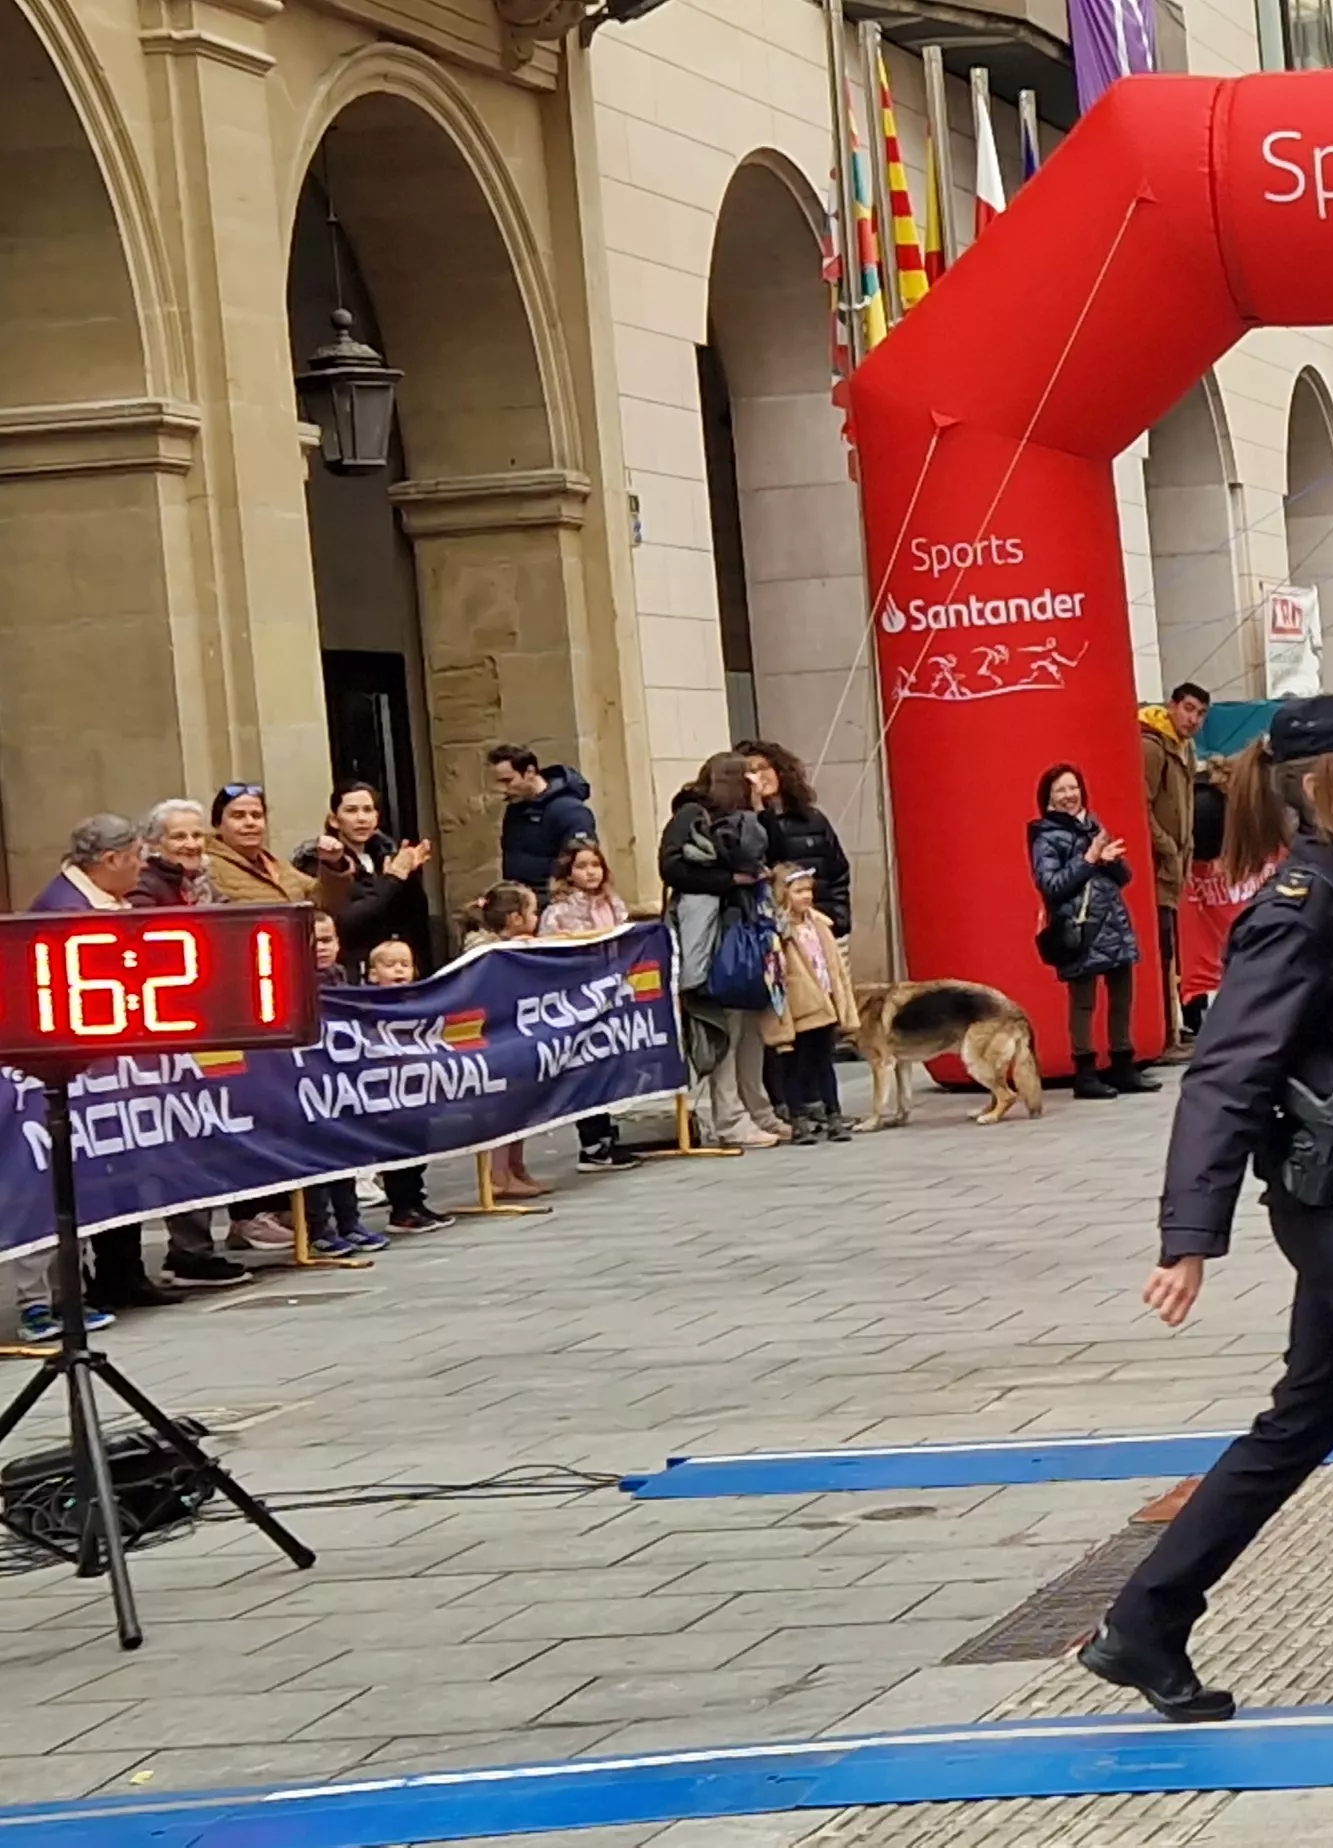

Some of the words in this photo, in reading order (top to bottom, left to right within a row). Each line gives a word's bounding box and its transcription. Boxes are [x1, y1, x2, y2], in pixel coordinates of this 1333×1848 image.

[911, 534, 1024, 578] Sports
[909, 588, 1085, 632] Santander
[537, 1008, 669, 1083] NACIONAL
[299, 1053, 508, 1123] NACIONAL
